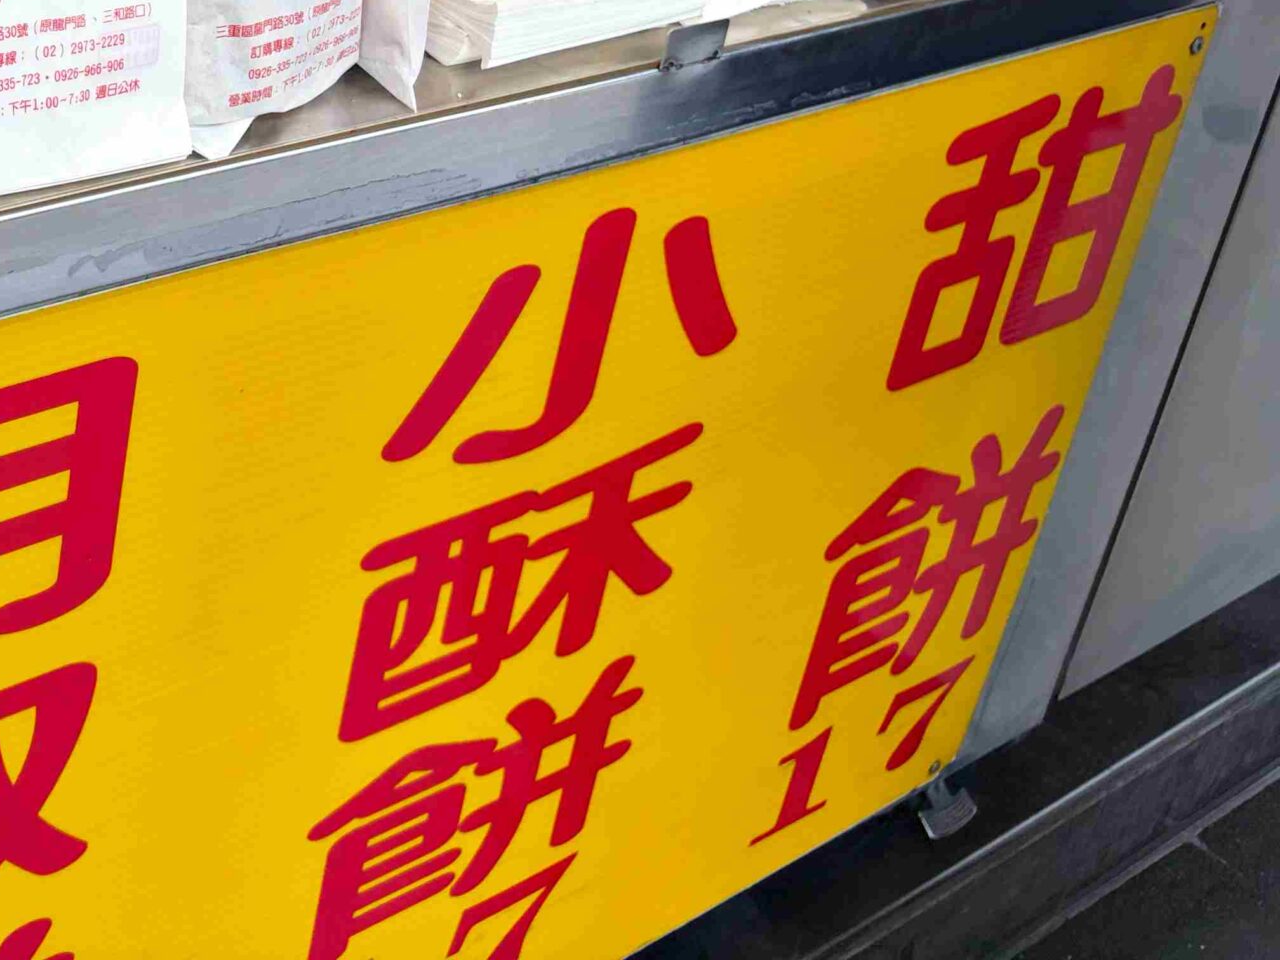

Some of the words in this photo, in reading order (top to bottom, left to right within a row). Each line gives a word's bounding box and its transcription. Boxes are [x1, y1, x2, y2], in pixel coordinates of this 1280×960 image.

[307, 206, 738, 960] 小酥餅
[789, 64, 1183, 732] 甜餅
[749, 655, 976, 847] 17
